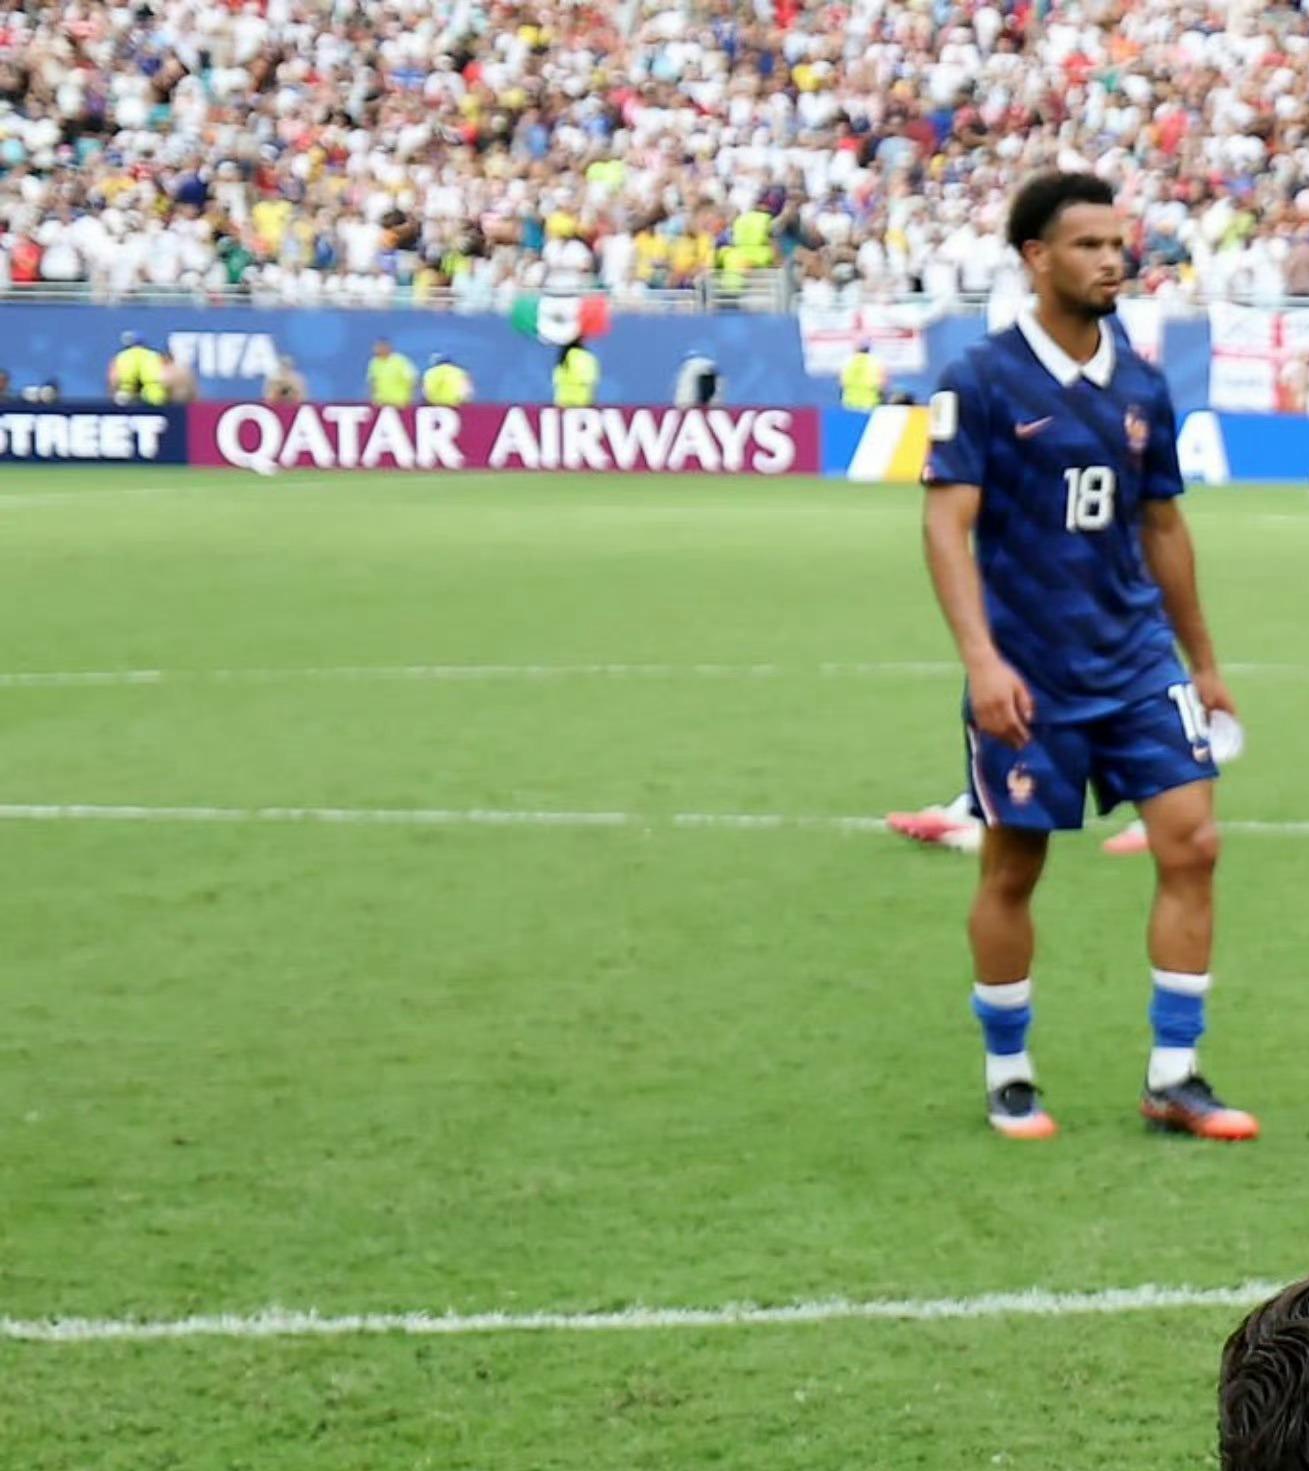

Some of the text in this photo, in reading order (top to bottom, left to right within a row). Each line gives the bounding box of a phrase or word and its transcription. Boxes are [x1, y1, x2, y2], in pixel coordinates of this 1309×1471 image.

[168, 331, 281, 379] FIFA
[0, 413, 167, 459] TREET
[216, 403, 797, 476] QATAR AIRWAYS
[1063, 466, 1116, 533] 18
